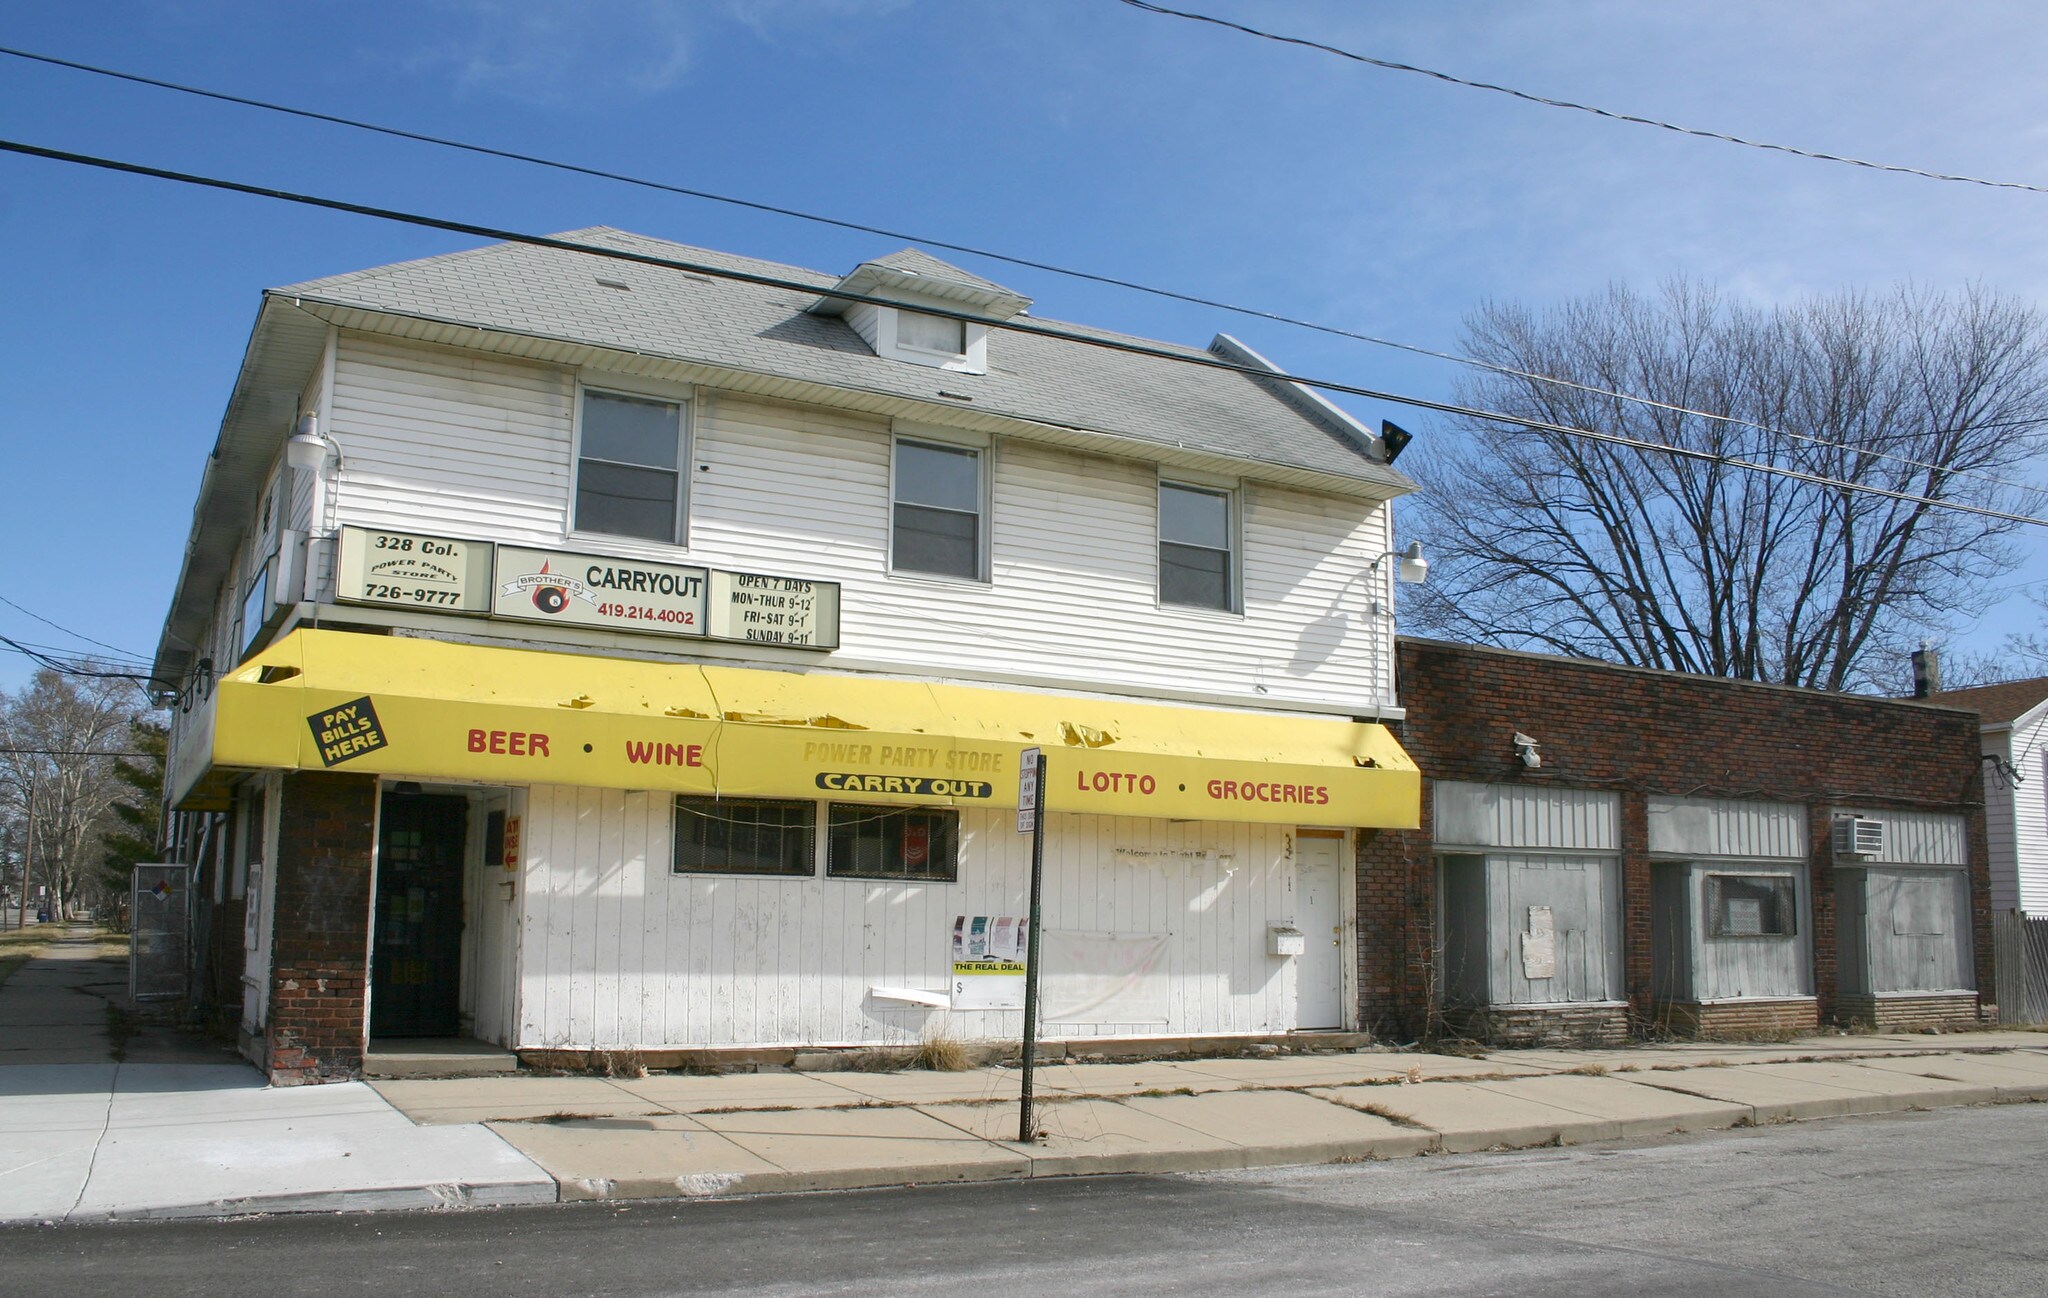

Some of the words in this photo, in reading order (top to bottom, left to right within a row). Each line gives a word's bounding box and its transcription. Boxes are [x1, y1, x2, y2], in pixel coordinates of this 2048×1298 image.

[375, 536, 413, 552] 328
[421, 541, 458, 557] Col.
[371, 559, 416, 573] POWER
[421, 561, 458, 581] PARTY
[392, 570, 438, 579] STORE
[520, 576, 581, 590] BROTHER'S
[586, 565, 702, 598] CARRYOUT
[738, 574, 769, 589] OPEN
[773, 578, 780, 590] 7
[784, 580, 812, 594] DAYS
[365, 583, 461, 605] 726-9777
[731, 591, 785, 609] MON-THUR
[598, 602, 694, 625] 419.214.4002
[743, 610, 785, 626] FRI-SAT
[746, 628, 784, 644] SUNDAY
[323, 705, 357, 728] PAY
[321, 716, 372, 744] BILLS
[324, 730, 380, 761] HERE
[467, 728, 549, 757] BEER
[626, 740, 702, 767] WINE
[803, 741, 873, 765] POWER
[879, 745, 939, 768] PARTY
[945, 749, 1003, 773] STORE
[823, 773, 922, 793] CARRY
[930, 779, 984, 797] OUT
[1078, 770, 1156, 795] LOTTO
[1207, 779, 1329, 805] GROCERIES
[954, 963, 973, 971] THE
[975, 963, 999, 971] REAL
[1000, 963, 1024, 971] DEAL
